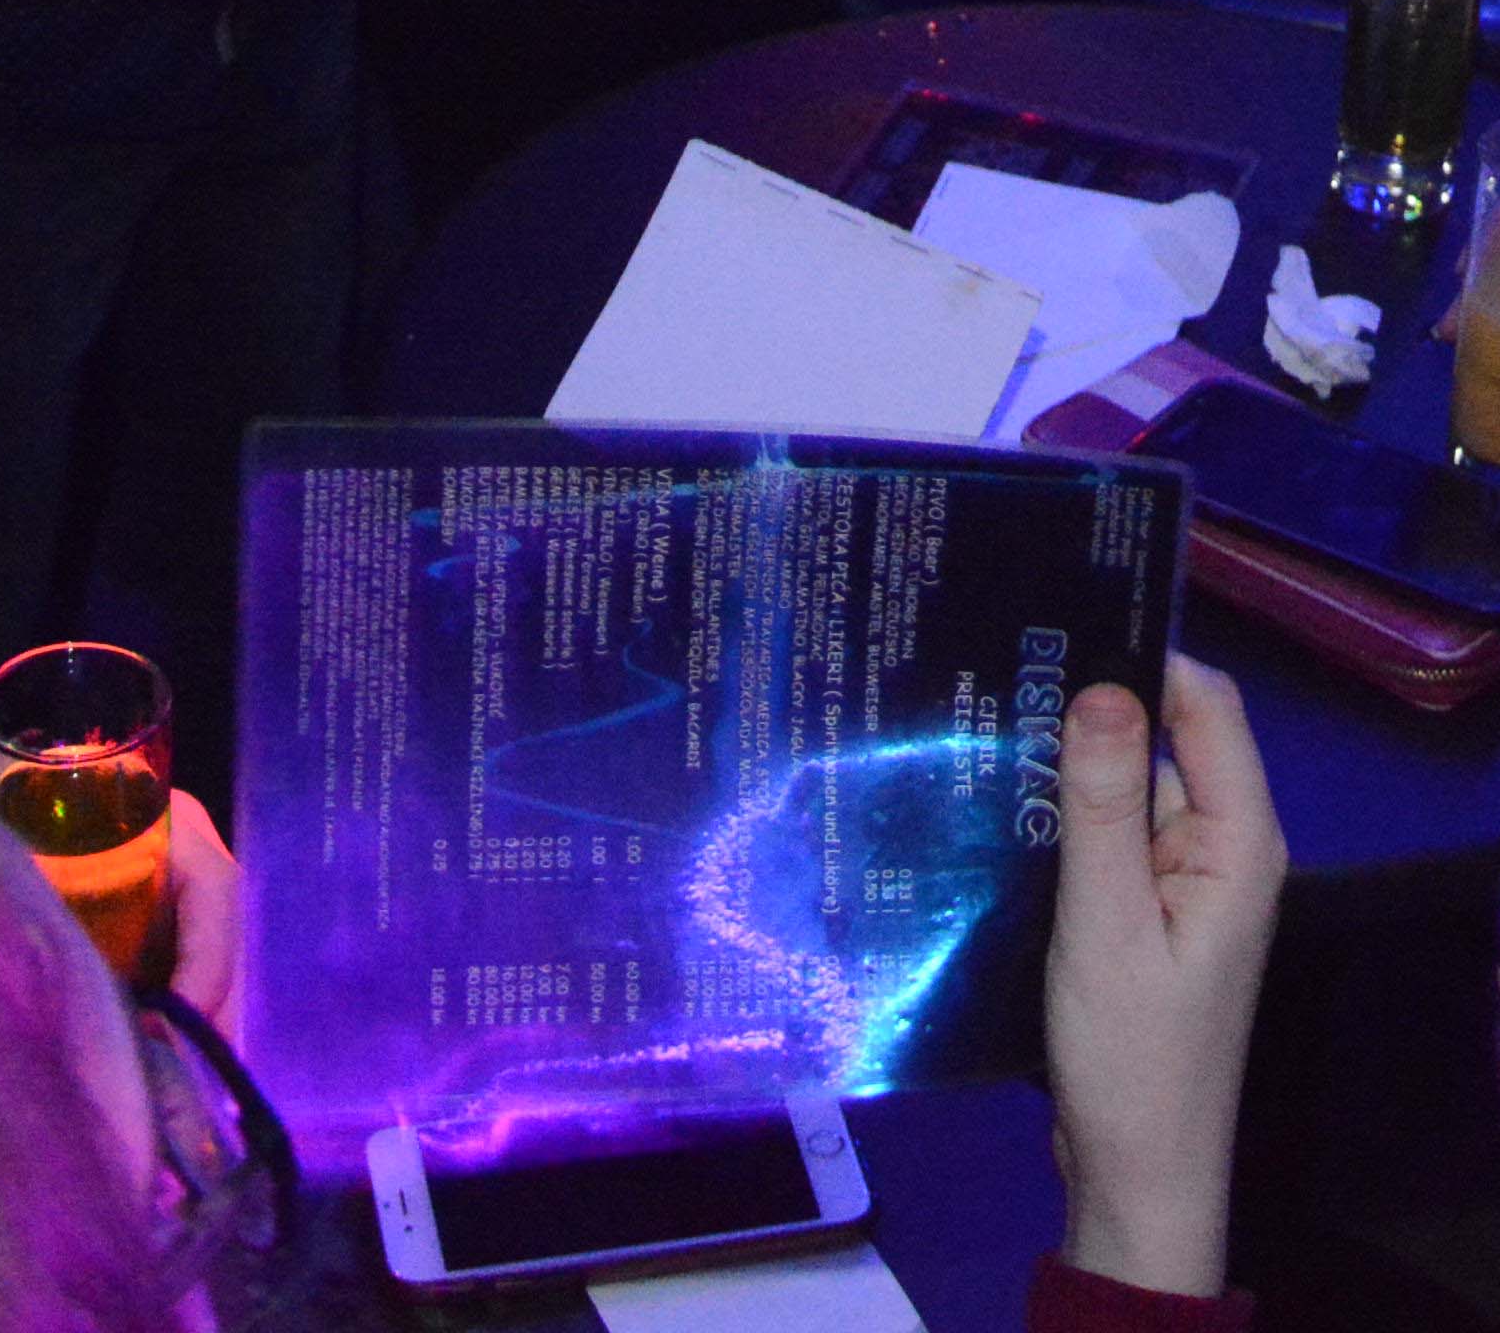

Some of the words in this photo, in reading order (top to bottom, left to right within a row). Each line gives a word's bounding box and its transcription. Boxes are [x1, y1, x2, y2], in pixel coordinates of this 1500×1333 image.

[655, 468, 673, 516] VINA
[929, 478, 947, 520] PIVO
[651, 535, 671, 589] Weine
[924, 536, 943, 574] Beer
[826, 620, 844, 684] LIKERI
[821, 704, 841, 805] Spirituosen
[954, 671, 974, 797] PREISLISTE
[979, 696, 996, 775] CJENIK
[824, 812, 840, 843] und
